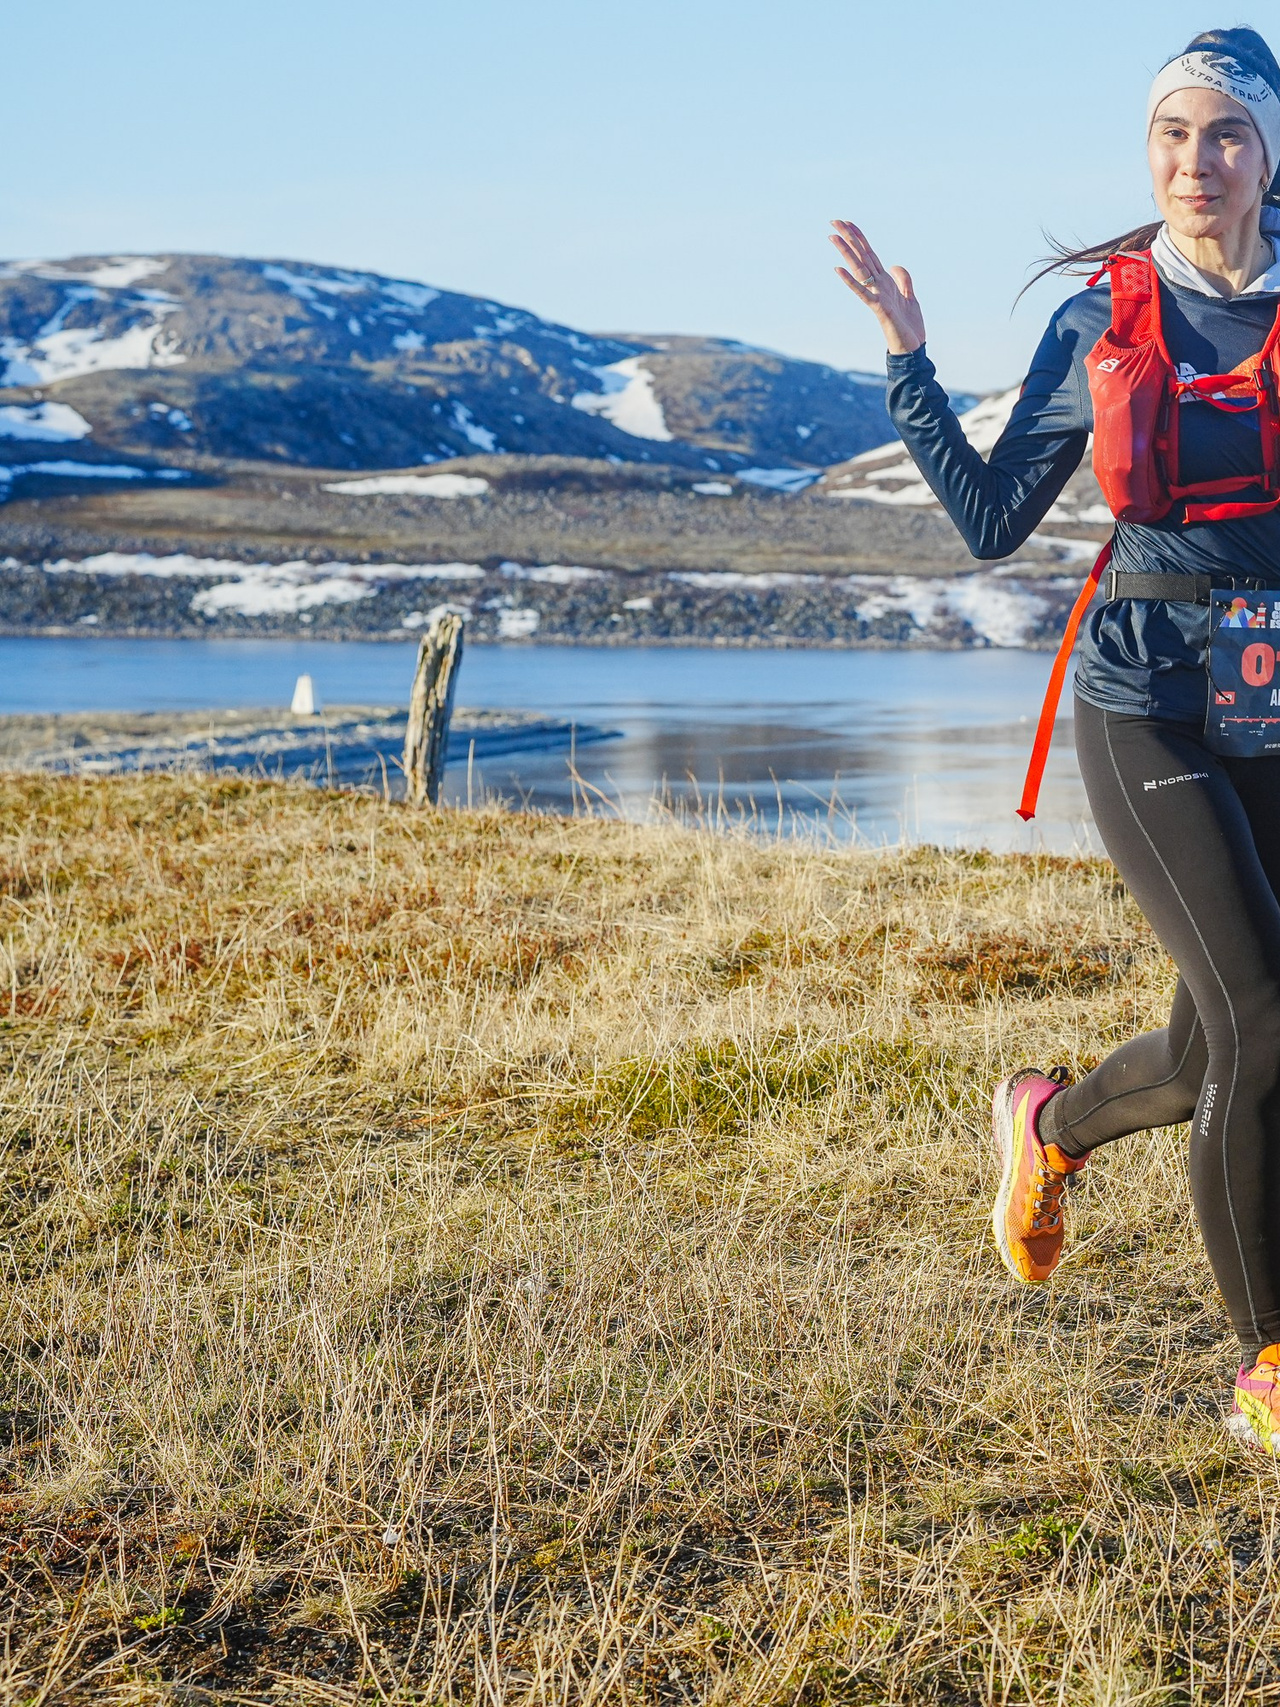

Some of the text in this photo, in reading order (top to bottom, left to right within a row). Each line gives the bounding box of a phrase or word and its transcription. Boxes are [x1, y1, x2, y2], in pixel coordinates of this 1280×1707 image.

[1184, 65, 1223, 88] ULTRA
[1229, 85, 1262, 103] TRAIL
[1158, 772, 1209, 787] NORDSKI
[1199, 1083, 1218, 1137] WARM
